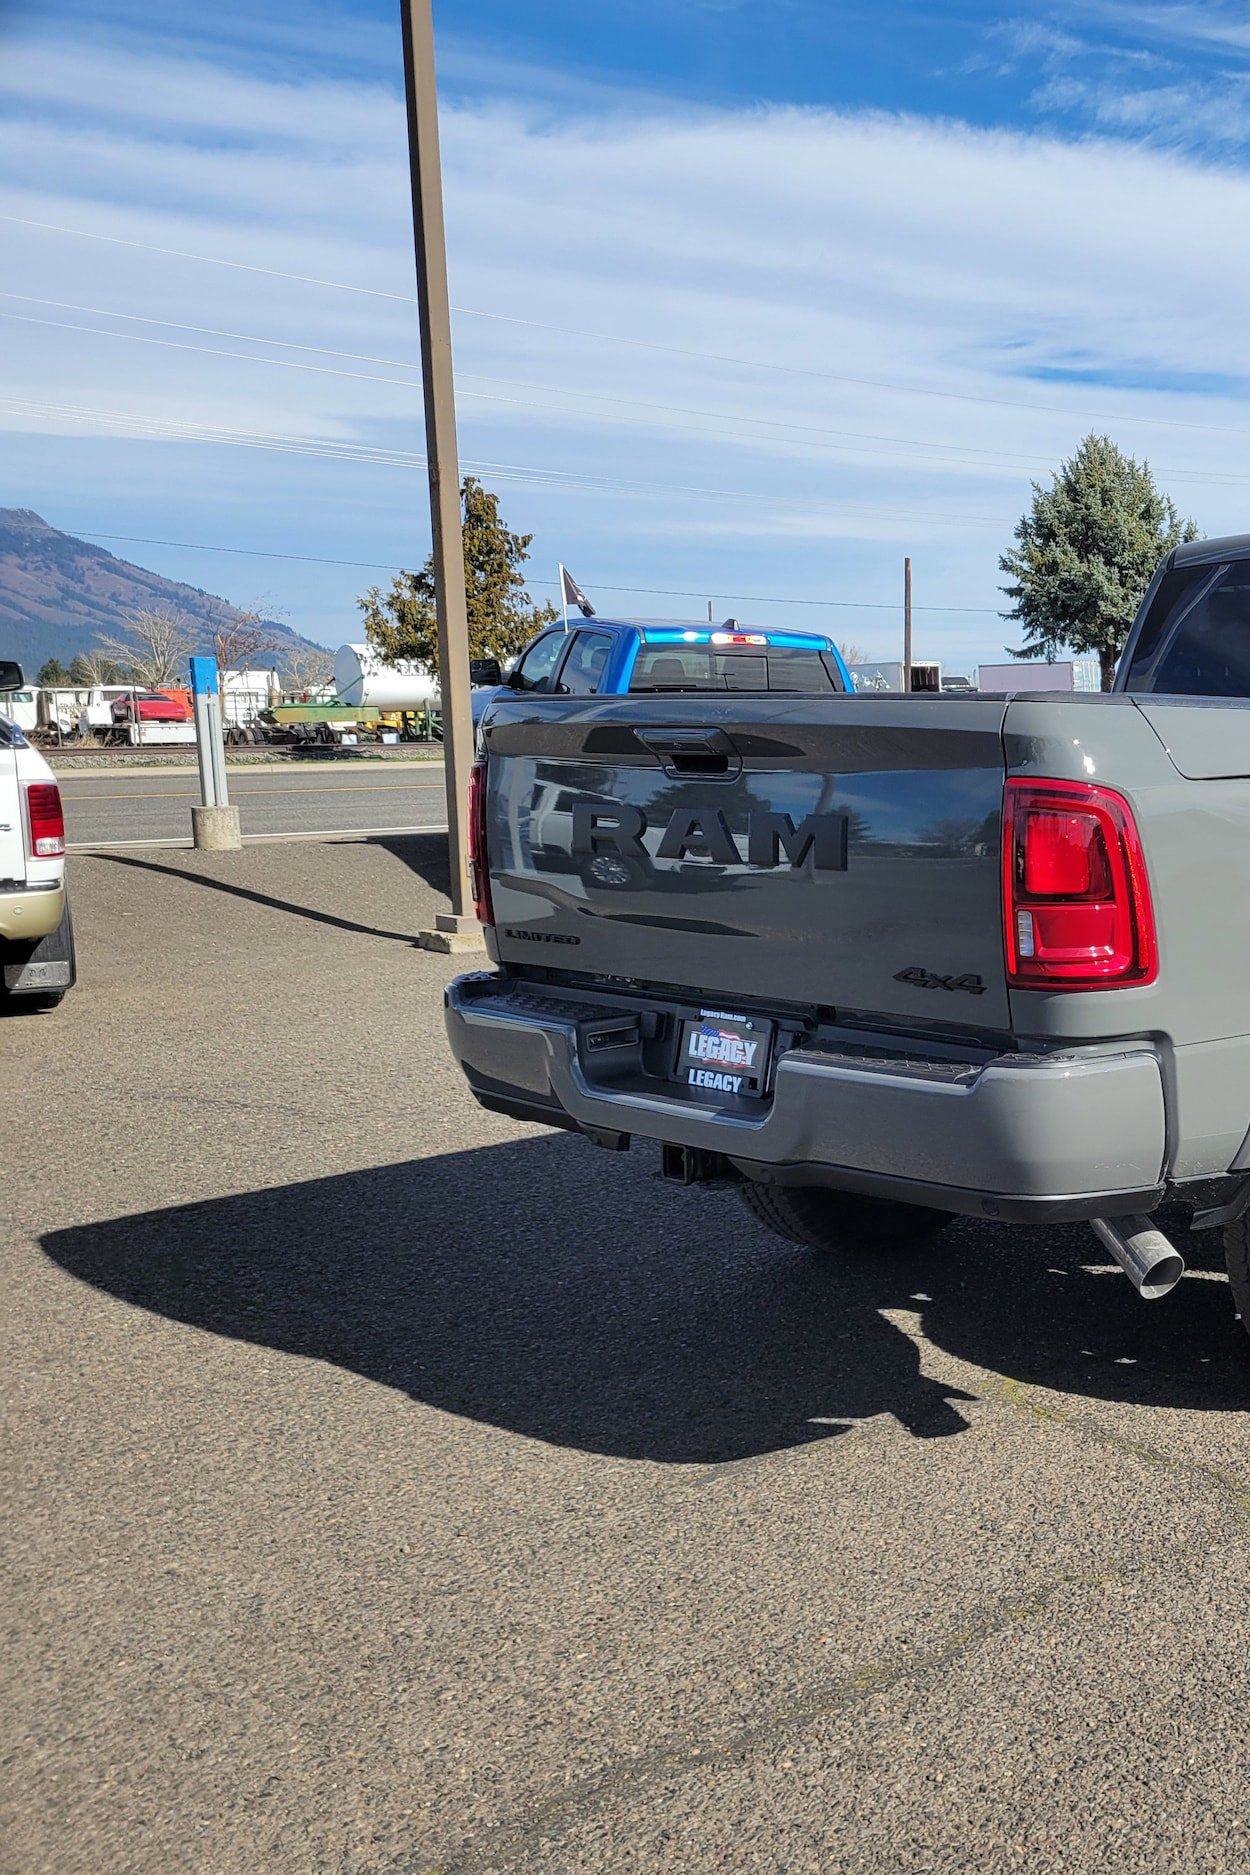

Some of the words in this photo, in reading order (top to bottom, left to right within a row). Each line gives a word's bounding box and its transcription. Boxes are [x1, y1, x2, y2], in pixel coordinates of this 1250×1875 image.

[572, 802, 848, 871] RAM
[504, 928, 581, 945] LIMITED
[892, 966, 988, 995] 4x4
[688, 1032, 758, 1066] LEGACY
[687, 1068, 742, 1093] LEGACY
